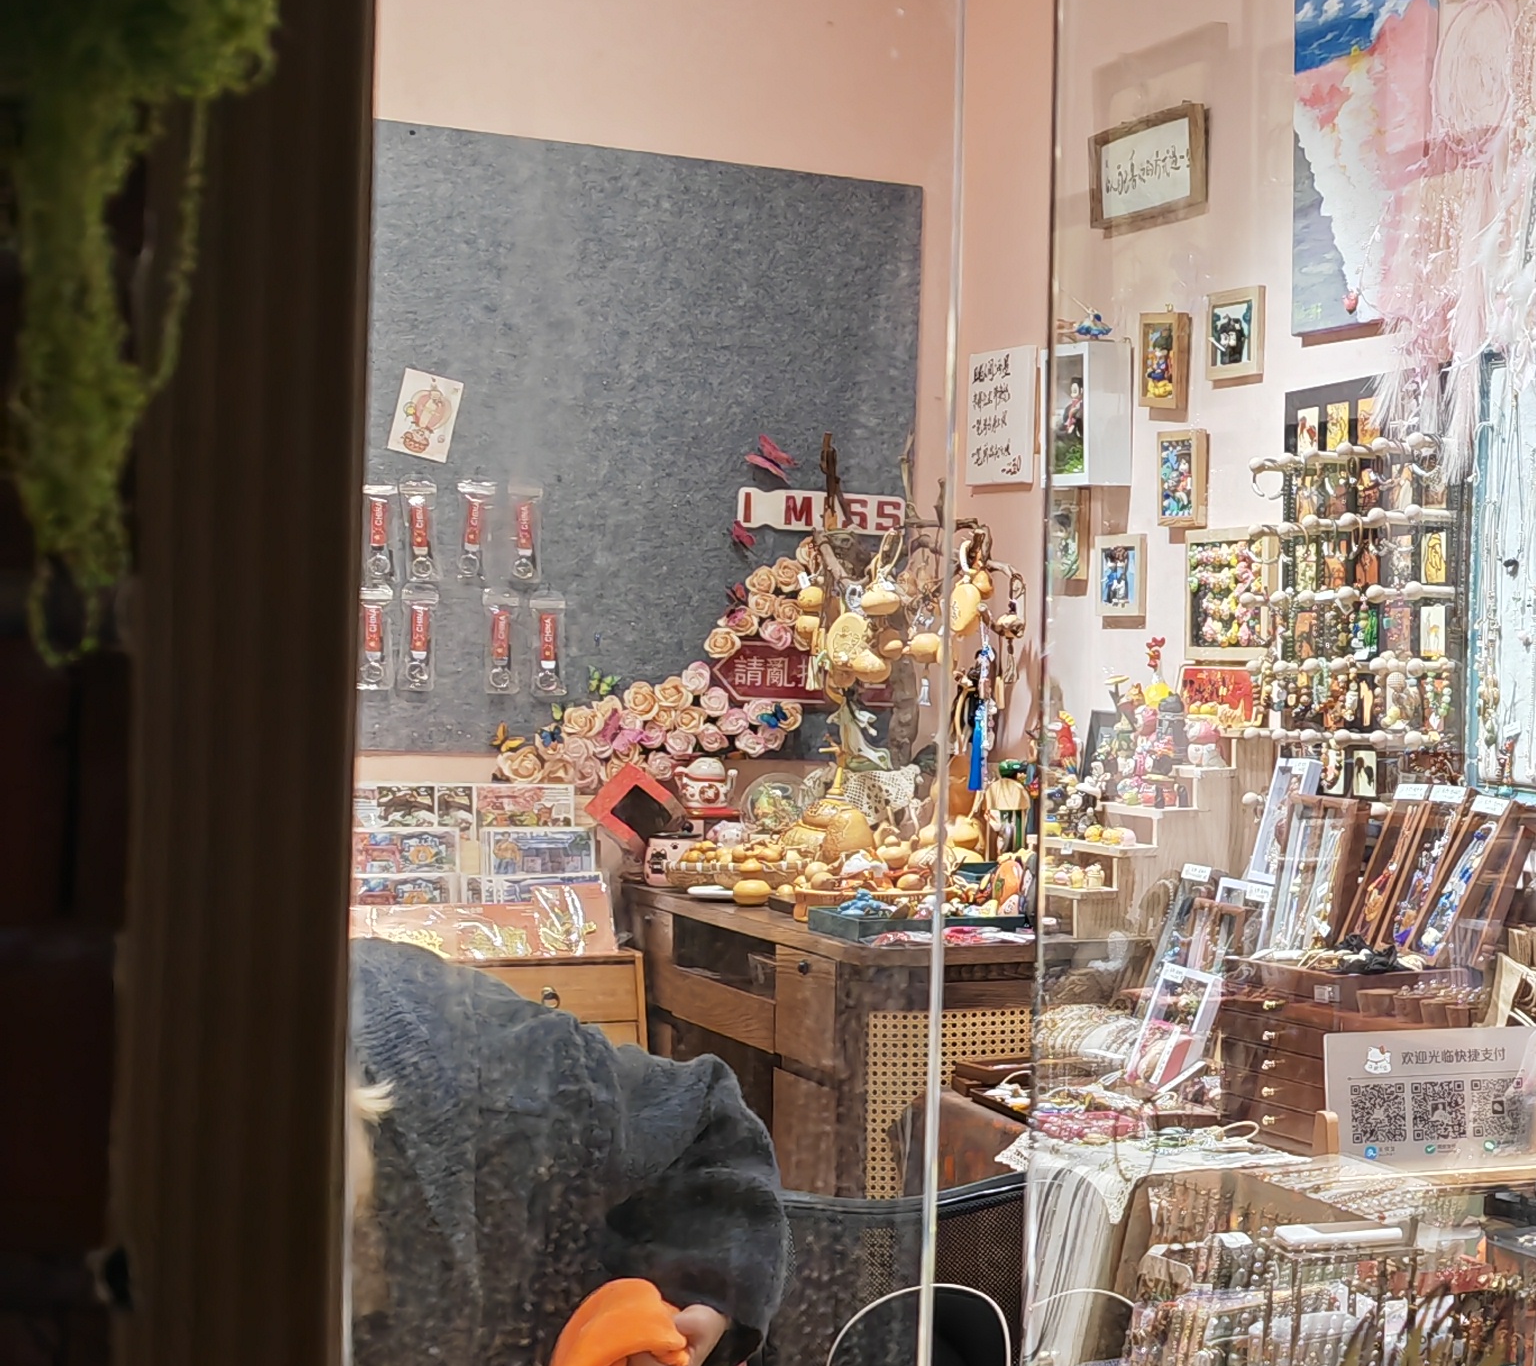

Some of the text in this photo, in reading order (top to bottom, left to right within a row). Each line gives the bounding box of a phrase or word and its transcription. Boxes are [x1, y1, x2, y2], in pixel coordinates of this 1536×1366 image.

[743, 492, 752, 523] I
[1400, 1046, 1506, 1066] 欢迎光临快捷支付
